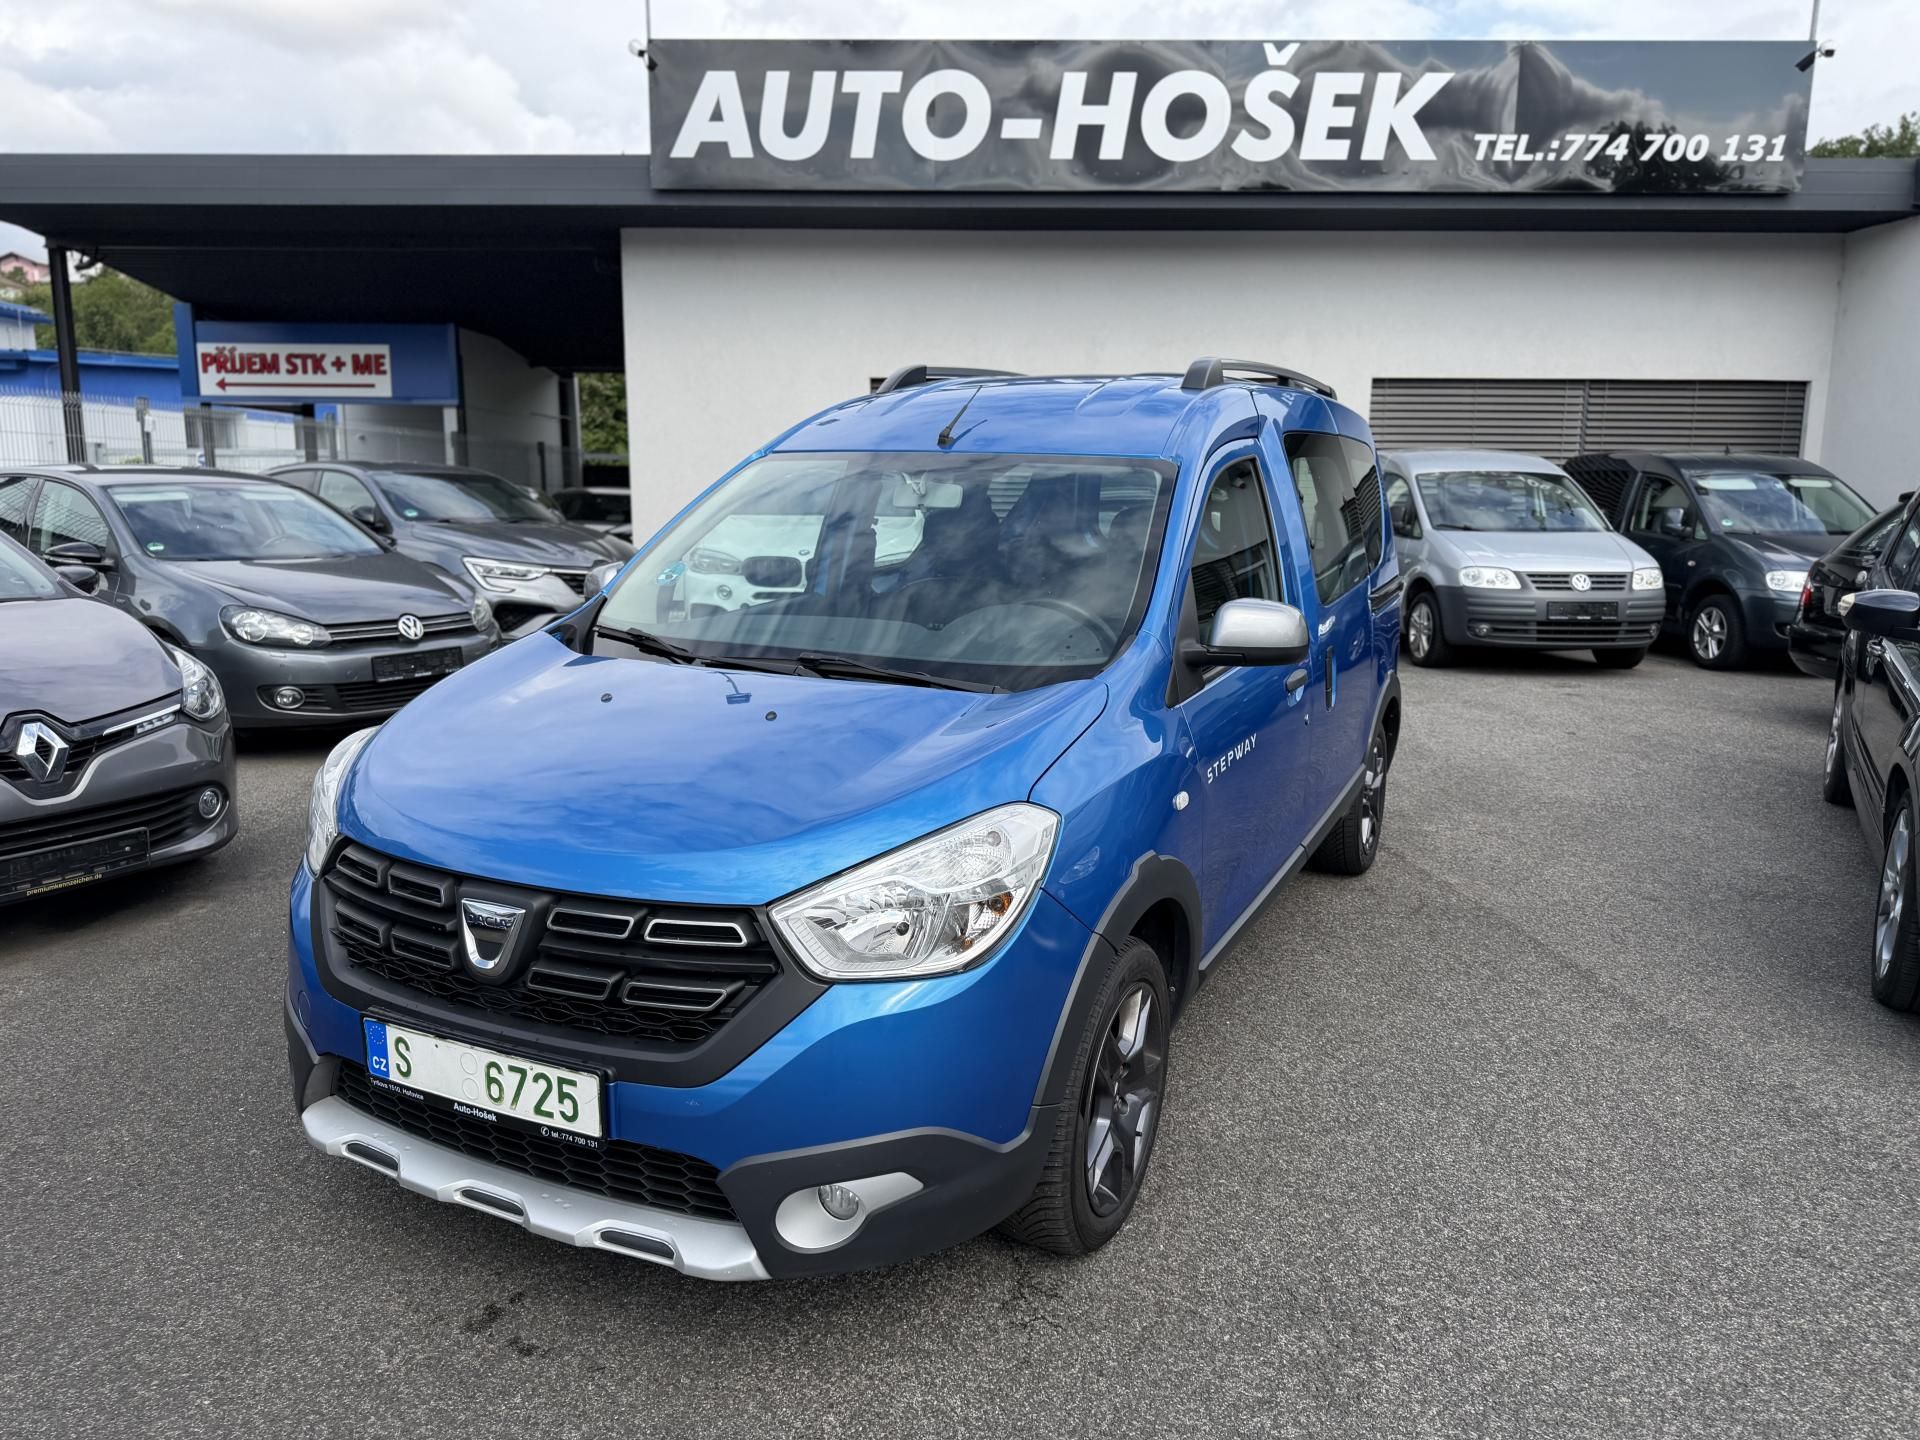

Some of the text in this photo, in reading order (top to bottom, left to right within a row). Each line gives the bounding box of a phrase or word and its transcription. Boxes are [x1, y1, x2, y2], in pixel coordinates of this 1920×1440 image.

[670, 42, 1455, 163] AUTO-HOŠEK
[1473, 134, 1786, 162] TEL.:774 700 131
[201, 346, 281, 375] PŘÍJEM
[285, 353, 328, 376] STK
[351, 353, 388, 376] ME
[1207, 732, 1257, 785] STEPWAY
[26, 872, 103, 897] premiumkennzeichen.de
[372, 1056, 388, 1072] CZ
[394, 1036, 579, 1123] S 6725
[453, 1102, 498, 1122] Auto-Hošek
[574, 1135, 586, 1146] 700
[587, 1139, 598, 1149] 131
